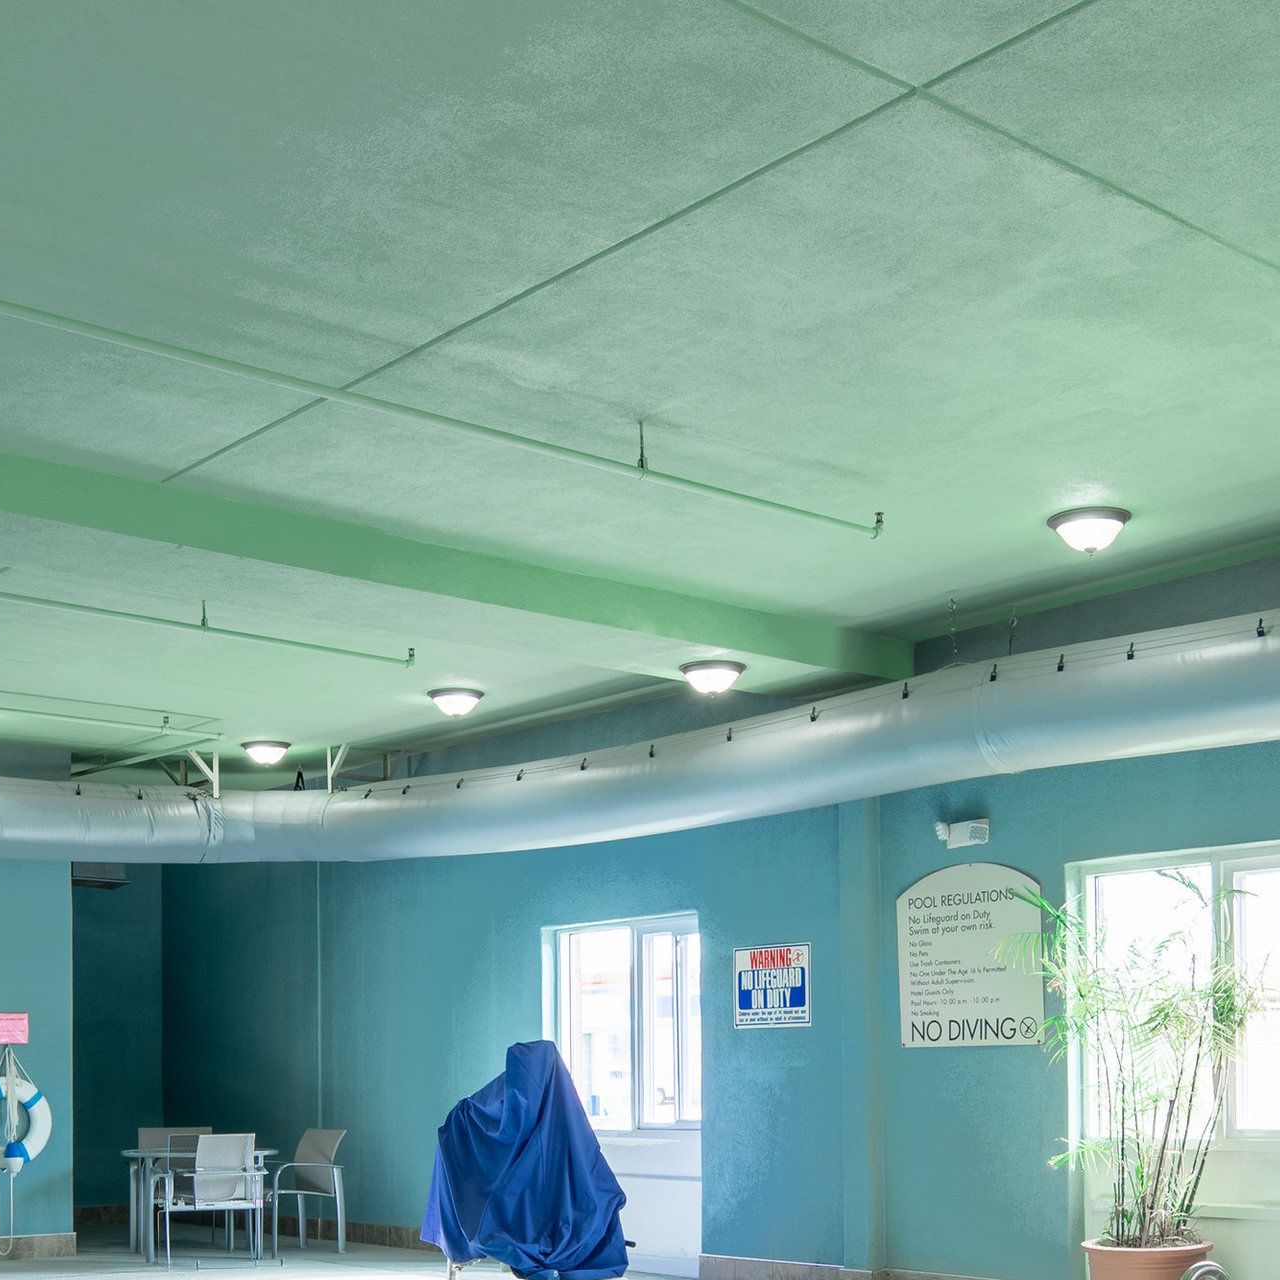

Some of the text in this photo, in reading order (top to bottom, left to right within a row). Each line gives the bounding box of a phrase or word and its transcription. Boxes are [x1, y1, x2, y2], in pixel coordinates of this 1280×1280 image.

[908, 888, 1015, 910] POOL REGULATIONS
[909, 916, 920, 925] No
[923, 912, 958, 926] Lifeguard
[974, 910, 991, 920] Duty
[909, 921, 996, 936] Swim at your own risk.
[750, 948, 791, 969] WARNING
[742, 968, 801, 990] NO LIFEGUARD
[958, 968, 968, 976] Age
[983, 965, 1007, 973] Permitted
[752, 988, 791, 1008] ON DUTY
[942, 988, 954, 996] Only
[912, 1017, 1016, 1042] NO DIVING
